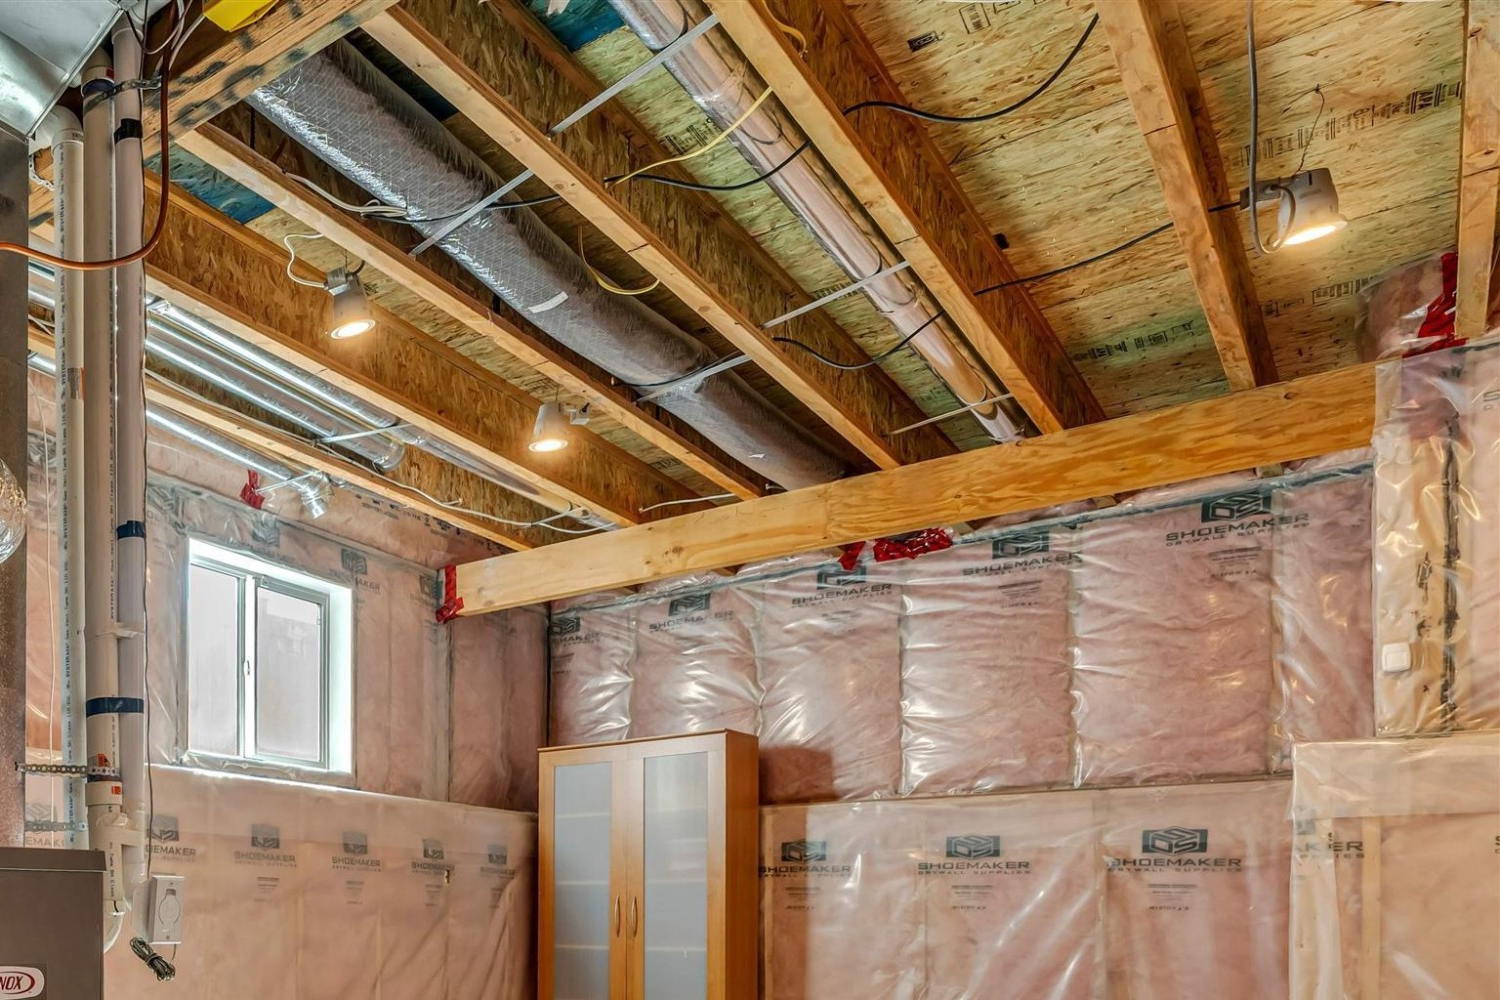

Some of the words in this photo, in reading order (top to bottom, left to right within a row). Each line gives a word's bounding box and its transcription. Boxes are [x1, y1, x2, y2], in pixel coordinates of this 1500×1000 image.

[1166, 513, 1310, 541] SHOEMAKER
[963, 551, 1083, 576] SHOEMAKER
[792, 583, 892, 605] SHOEMAKER
[649, 609, 733, 629] SHOEMAER
[234, 850, 296, 863] SHOEMAKER
[332, 856, 381, 868] SHOEMAKER
[758, 864, 851, 874] SHOEMAKER
[918, 861, 1030, 871] SHOEMAKER
